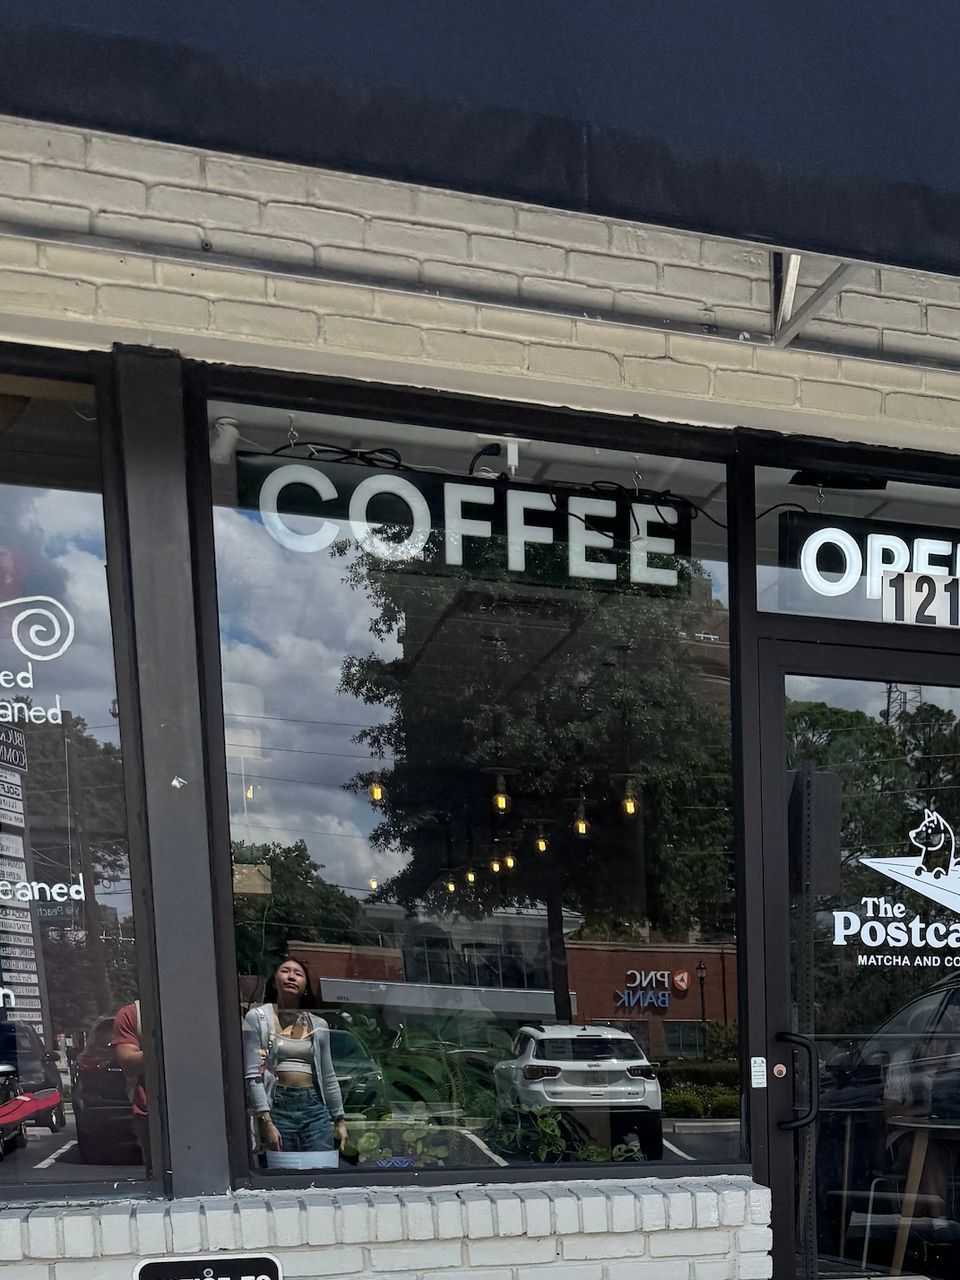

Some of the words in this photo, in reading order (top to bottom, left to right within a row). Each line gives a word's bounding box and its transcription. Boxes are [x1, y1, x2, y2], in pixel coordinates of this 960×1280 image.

[259, 464, 678, 586] COFFEE
[889, 574, 960, 626] 121
[861, 897, 906, 917] The
[858, 955, 911, 966] MATCHA
[914, 956, 941, 967] AND
